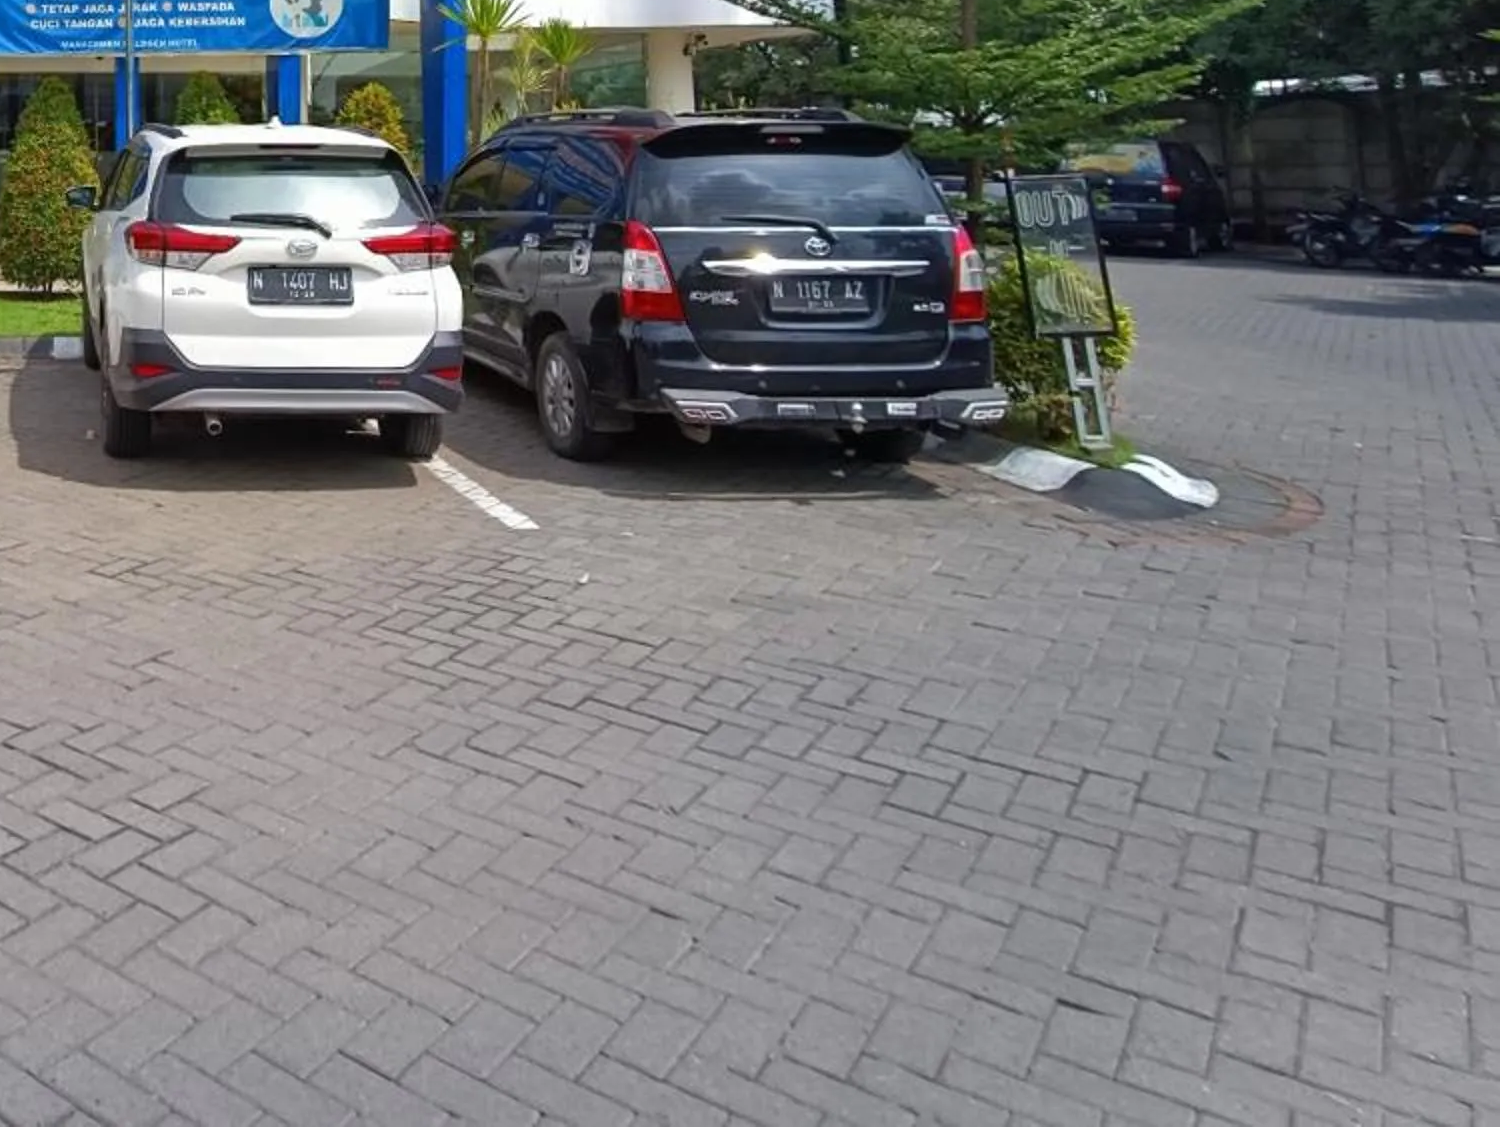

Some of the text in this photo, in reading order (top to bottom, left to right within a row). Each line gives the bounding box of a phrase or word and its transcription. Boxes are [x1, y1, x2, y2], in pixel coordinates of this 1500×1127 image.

[42, 4, 78, 14] TETAP
[83, 3, 115, 14] JAGA
[177, 2, 235, 12] WASPADA
[30, 20, 60, 30] CUCI
[62, 19, 113, 29] TANGAN
[133, 18, 165, 28] JAGA
[1015, 190, 1070, 227] OUT
[253, 271, 349, 291] N 1407 HJ
[773, 280, 864, 300] N 1167 AZ
